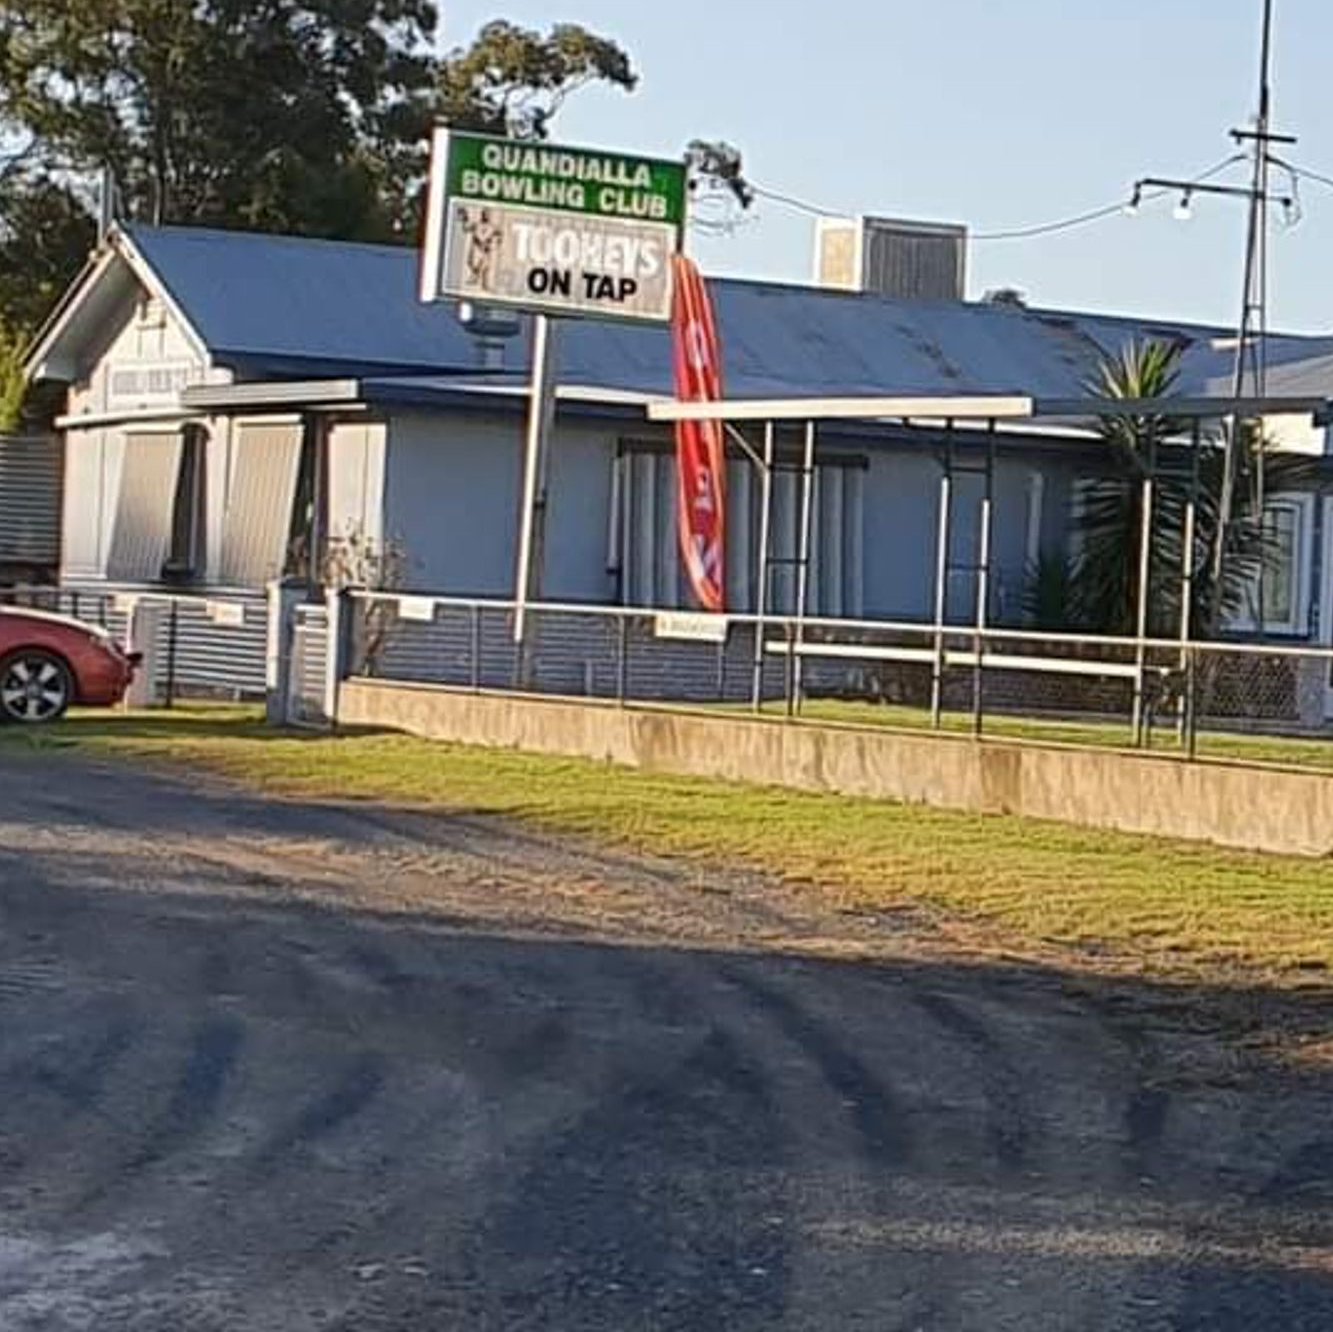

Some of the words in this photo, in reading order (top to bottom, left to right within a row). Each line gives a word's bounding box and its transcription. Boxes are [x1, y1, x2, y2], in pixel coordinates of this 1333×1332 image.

[482, 143, 651, 187] QUANDIALLA
[461, 170, 585, 208] BOWLING
[600, 187, 667, 218] CLUB
[511, 222, 660, 276] TOOHEYS
[527, 268, 571, 296] ON
[582, 271, 637, 303] TAP
